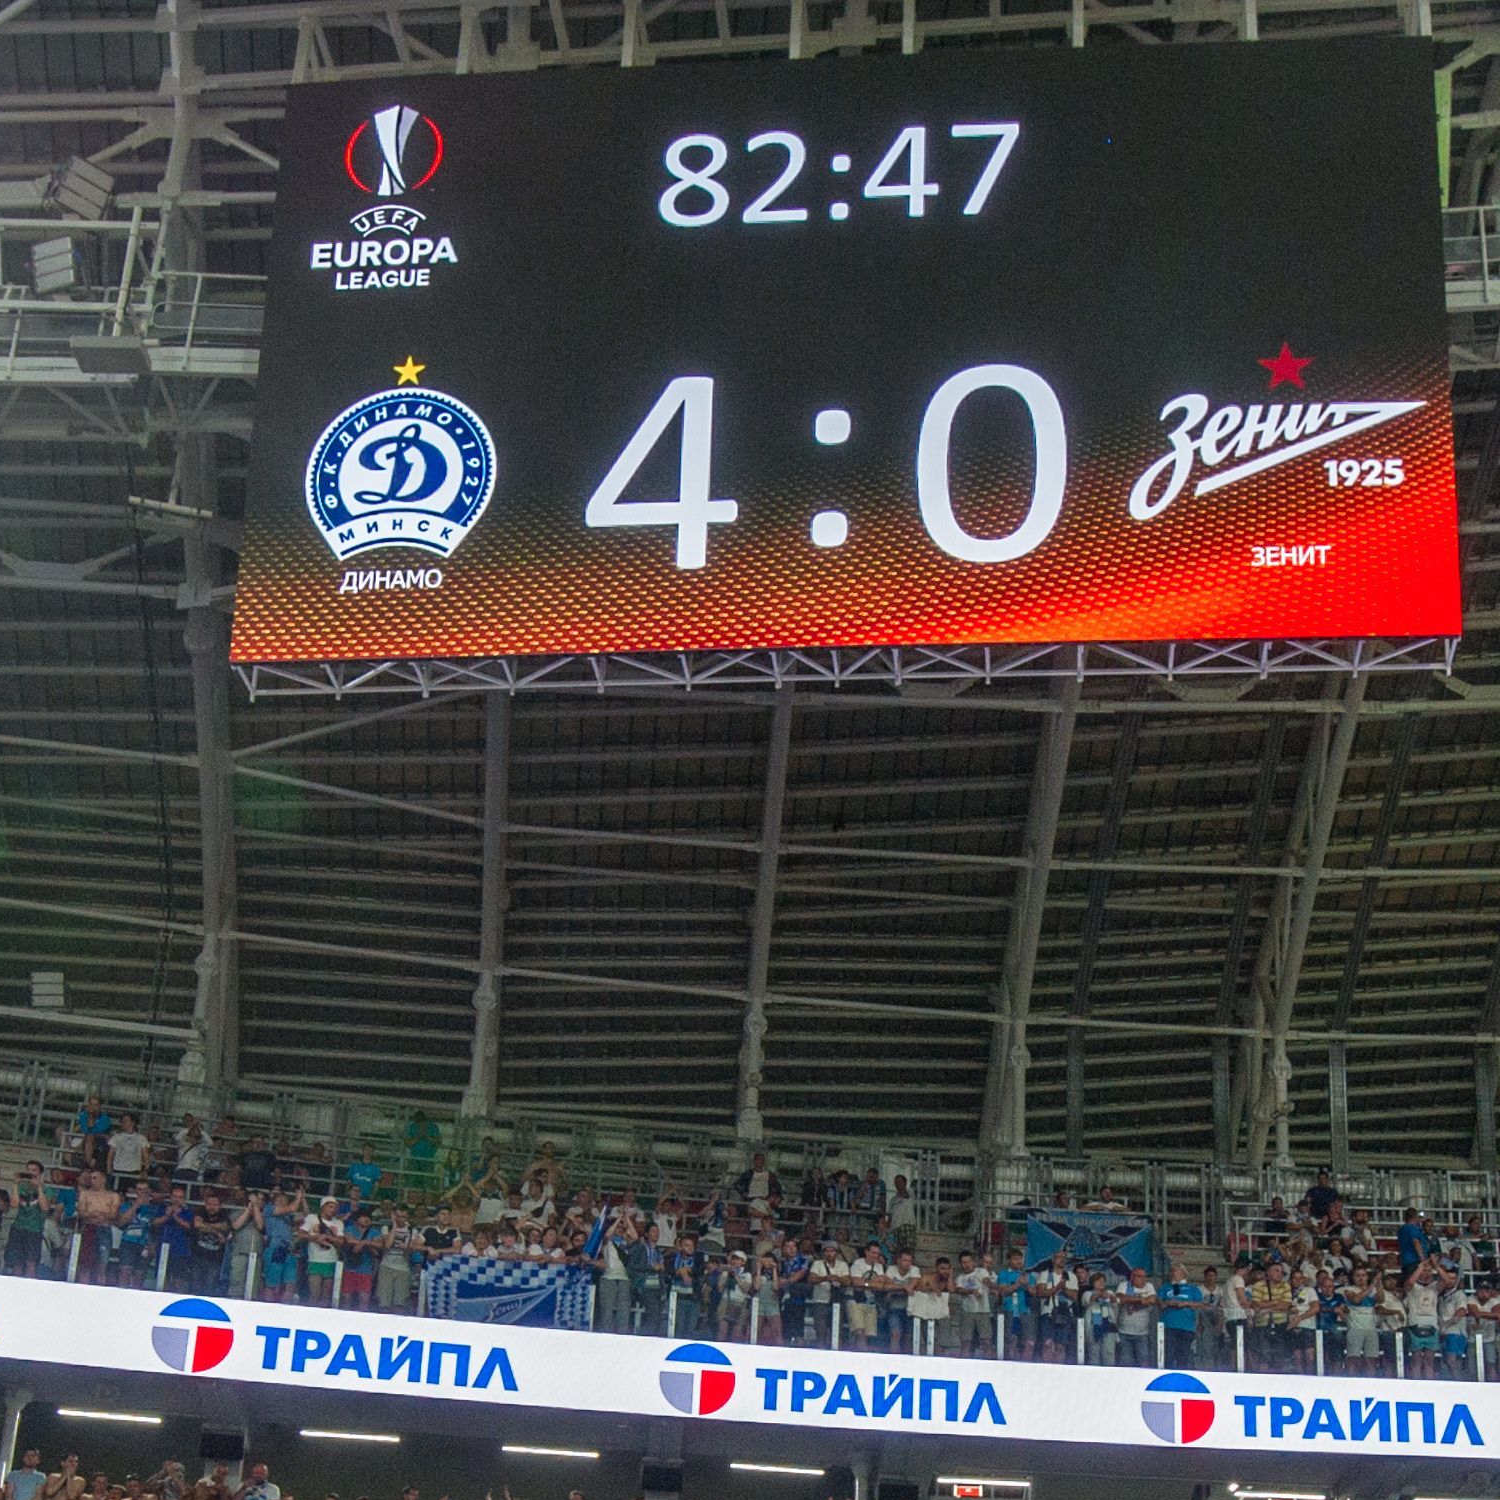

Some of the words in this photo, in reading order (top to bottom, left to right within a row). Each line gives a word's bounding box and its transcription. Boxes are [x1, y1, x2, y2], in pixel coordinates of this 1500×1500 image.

[659, 121, 1020, 230] 82:47
[354, 210, 419, 233] UEFA
[310, 237, 458, 270] EUROPA
[335, 268, 431, 291] LEAGUE
[1324, 459, 1407, 487] 1925
[338, 519, 454, 544] МИНСК
[1251, 544, 1332, 567] ЗЕНИТ
[339, 568, 443, 595] ДИНАМО
[254, 1325, 518, 1391] ТРАЙПЛ
[754, 1368, 1008, 1425] ТРАЙПЛ
[1233, 1395, 1485, 1446] ТРАЙПЛ
